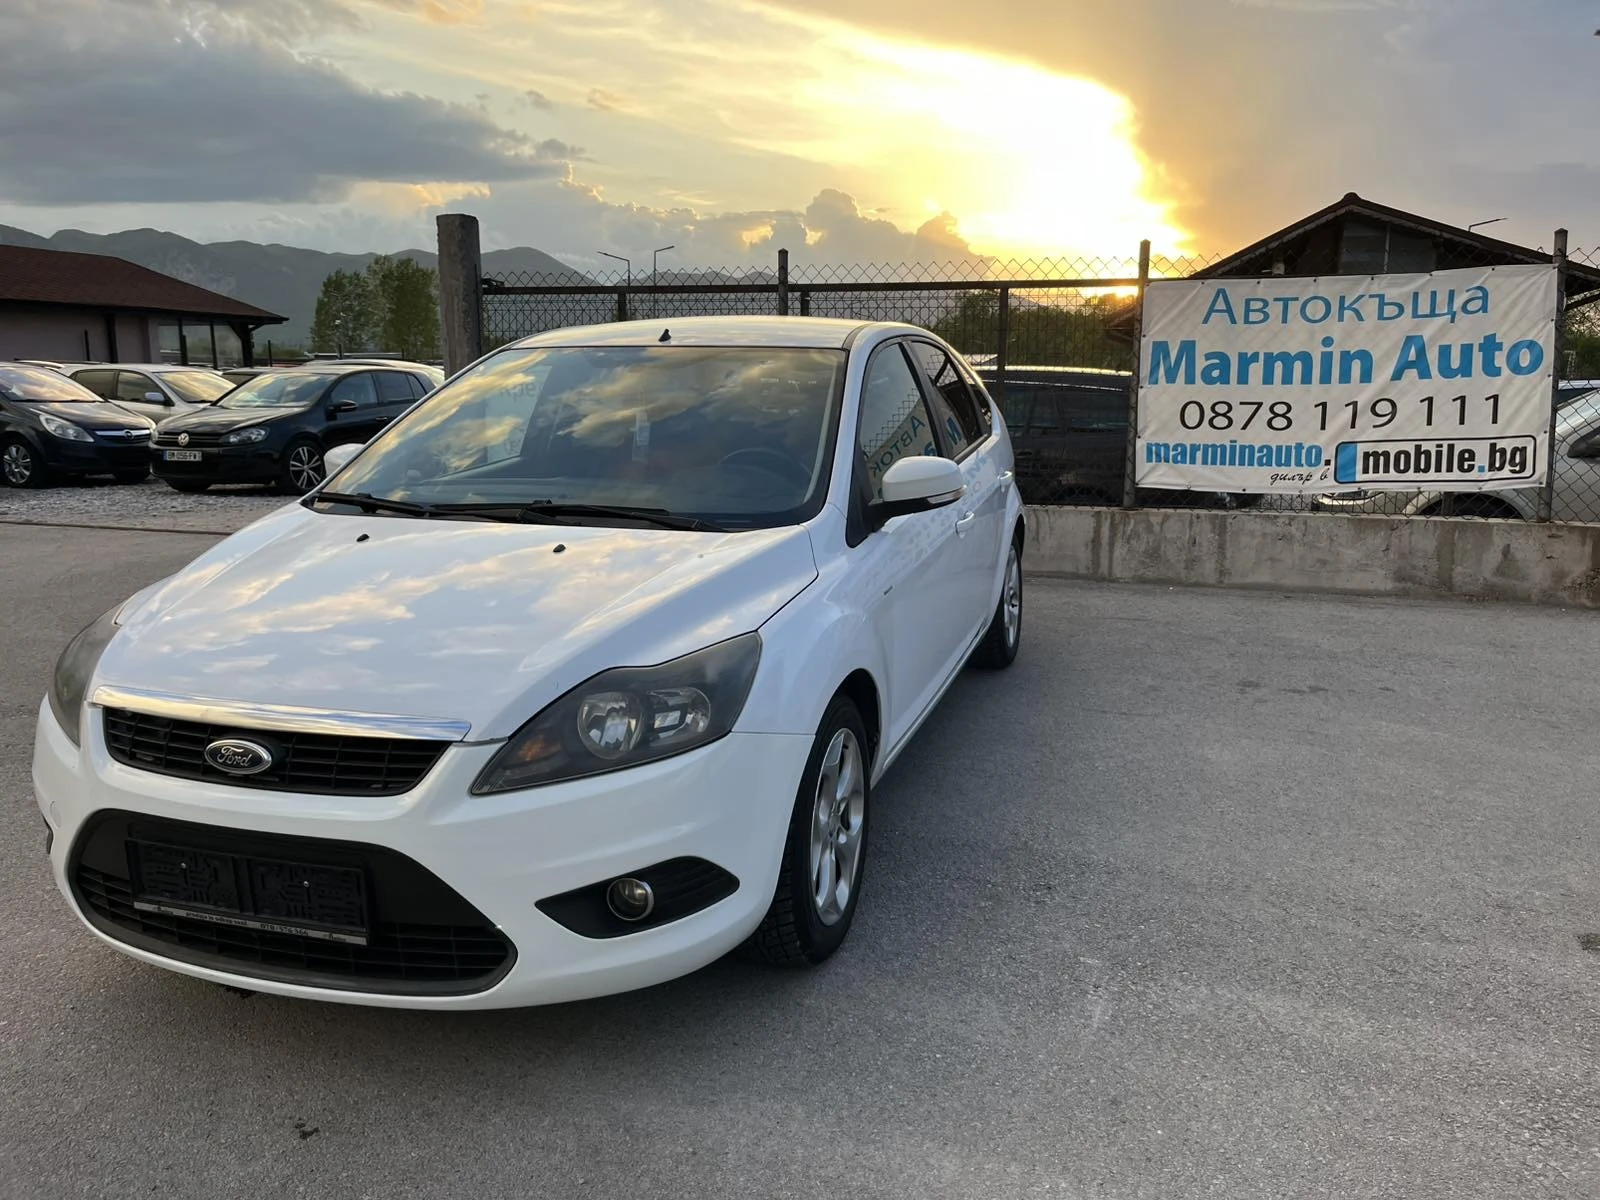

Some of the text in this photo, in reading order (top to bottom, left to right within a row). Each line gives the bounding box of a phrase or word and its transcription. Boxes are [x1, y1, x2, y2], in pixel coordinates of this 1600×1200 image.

[1202, 285, 1489, 325] Автокъща
[1148, 332, 1544, 386] Marmin Auto
[1179, 393, 1500, 431] 0878 119 111
[1362, 442, 1528, 474] mobile.bg
[217, 746, 252, 766] Ford
